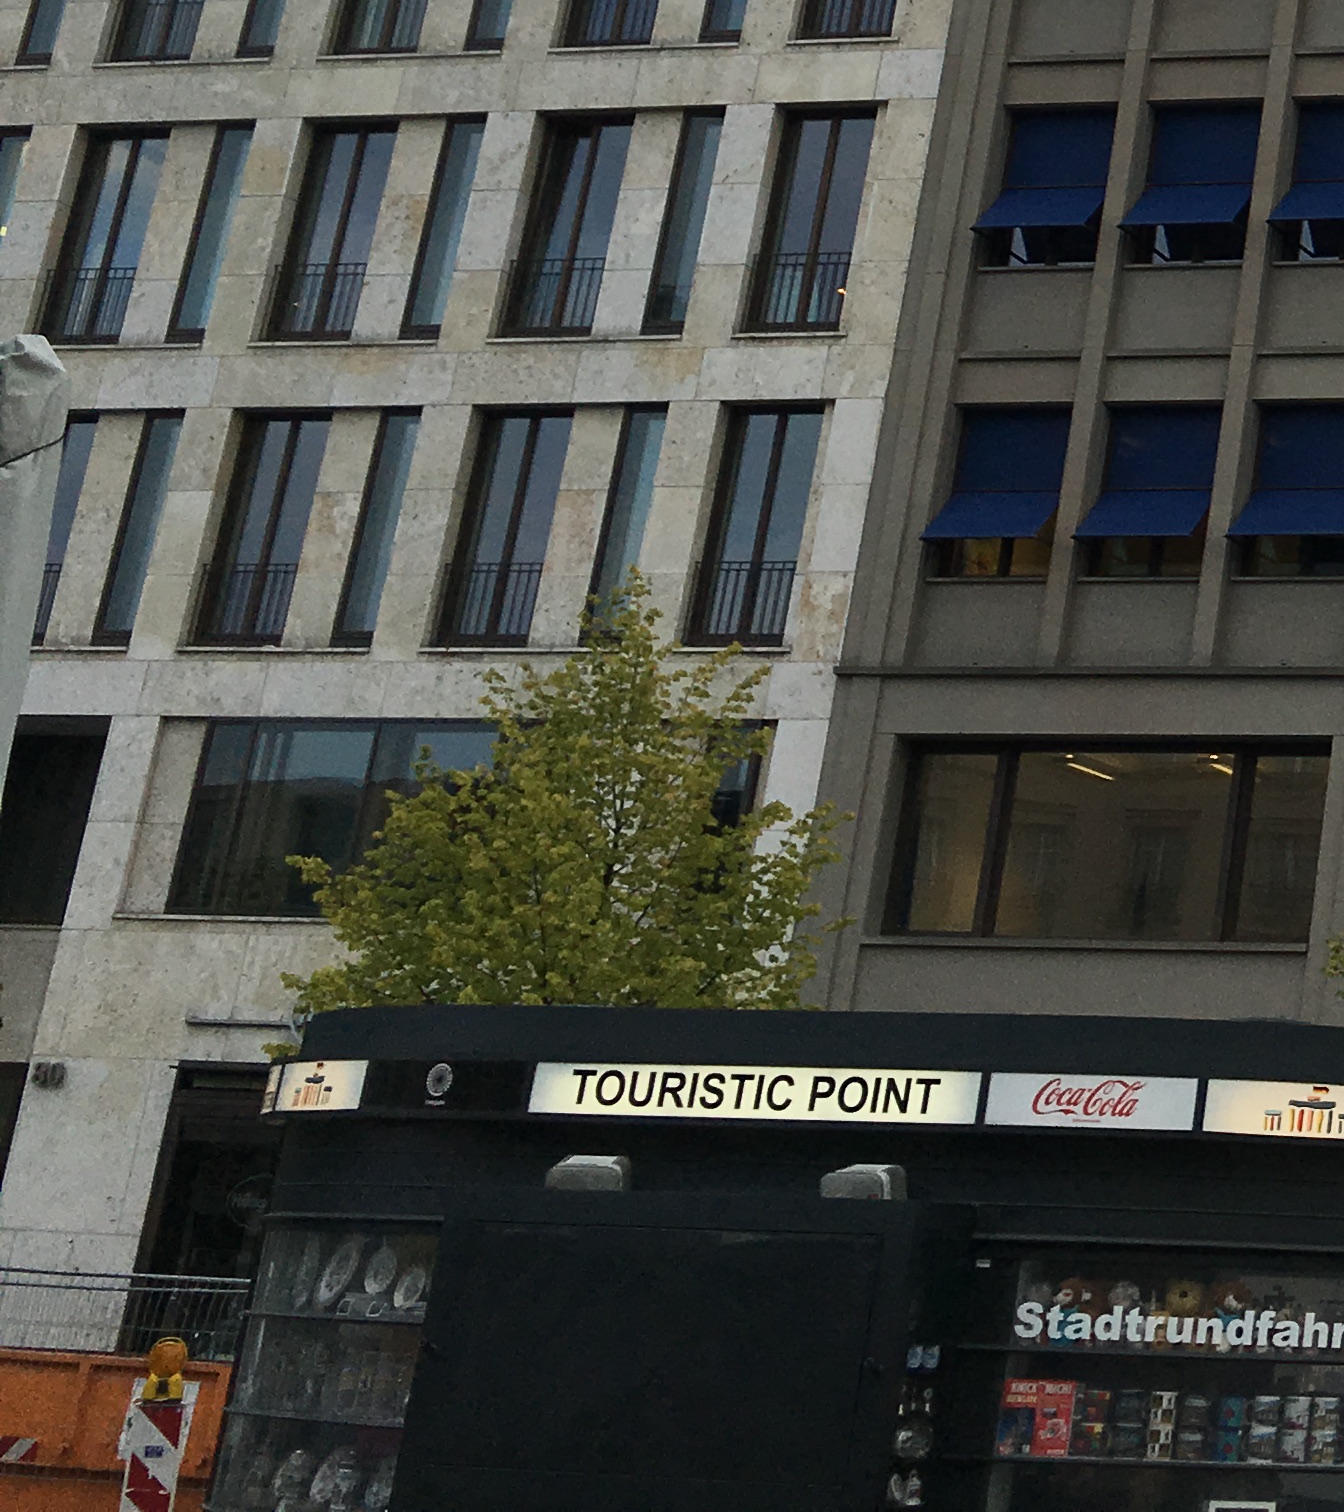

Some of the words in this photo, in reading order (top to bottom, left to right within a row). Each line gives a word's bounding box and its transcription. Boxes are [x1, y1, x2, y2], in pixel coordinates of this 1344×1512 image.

[572, 1068, 795, 1111] TOURISTIC
[809, 1076, 942, 1115] POINT
[1032, 1077, 1147, 1118] Coca-Cola
